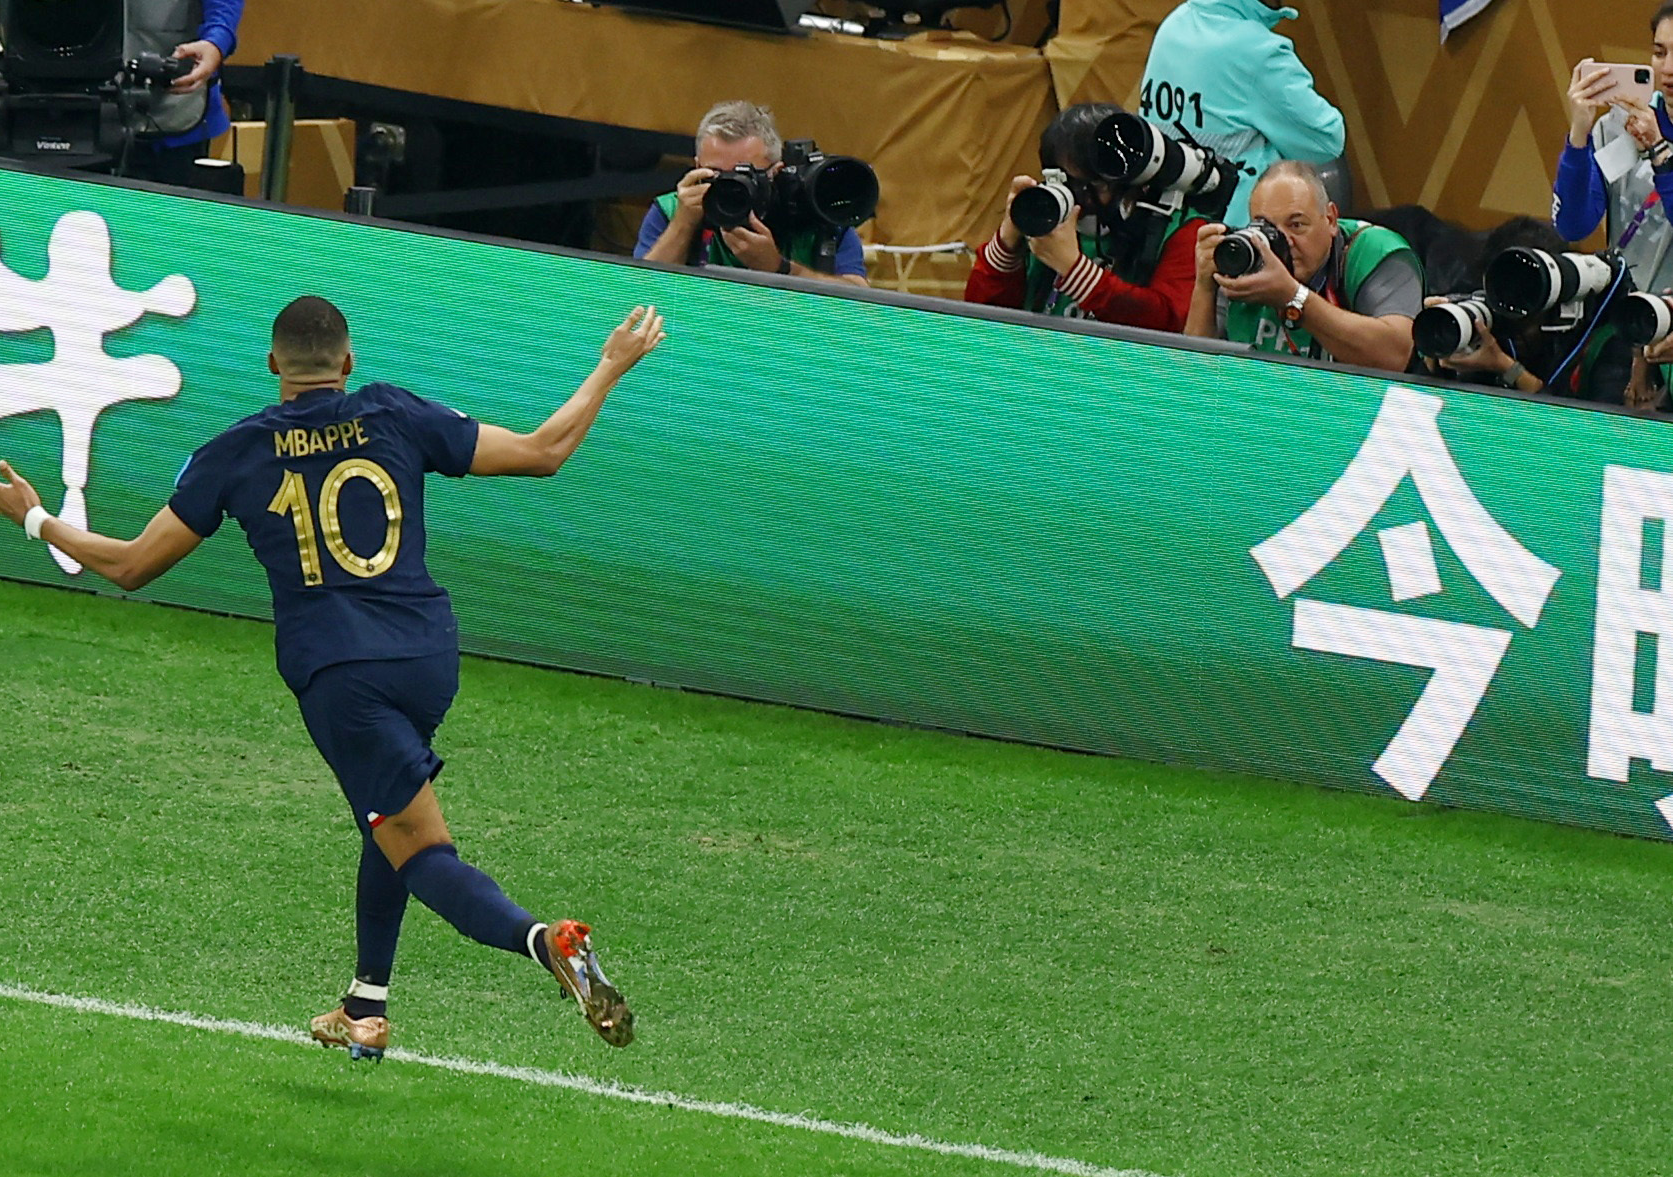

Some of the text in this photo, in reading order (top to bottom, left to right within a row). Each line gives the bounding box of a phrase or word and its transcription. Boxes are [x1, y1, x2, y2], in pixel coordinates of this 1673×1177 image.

[1141, 78, 1203, 129] 4091
[274, 417, 369, 457] MBAPPE
[267, 458, 403, 587] 10
